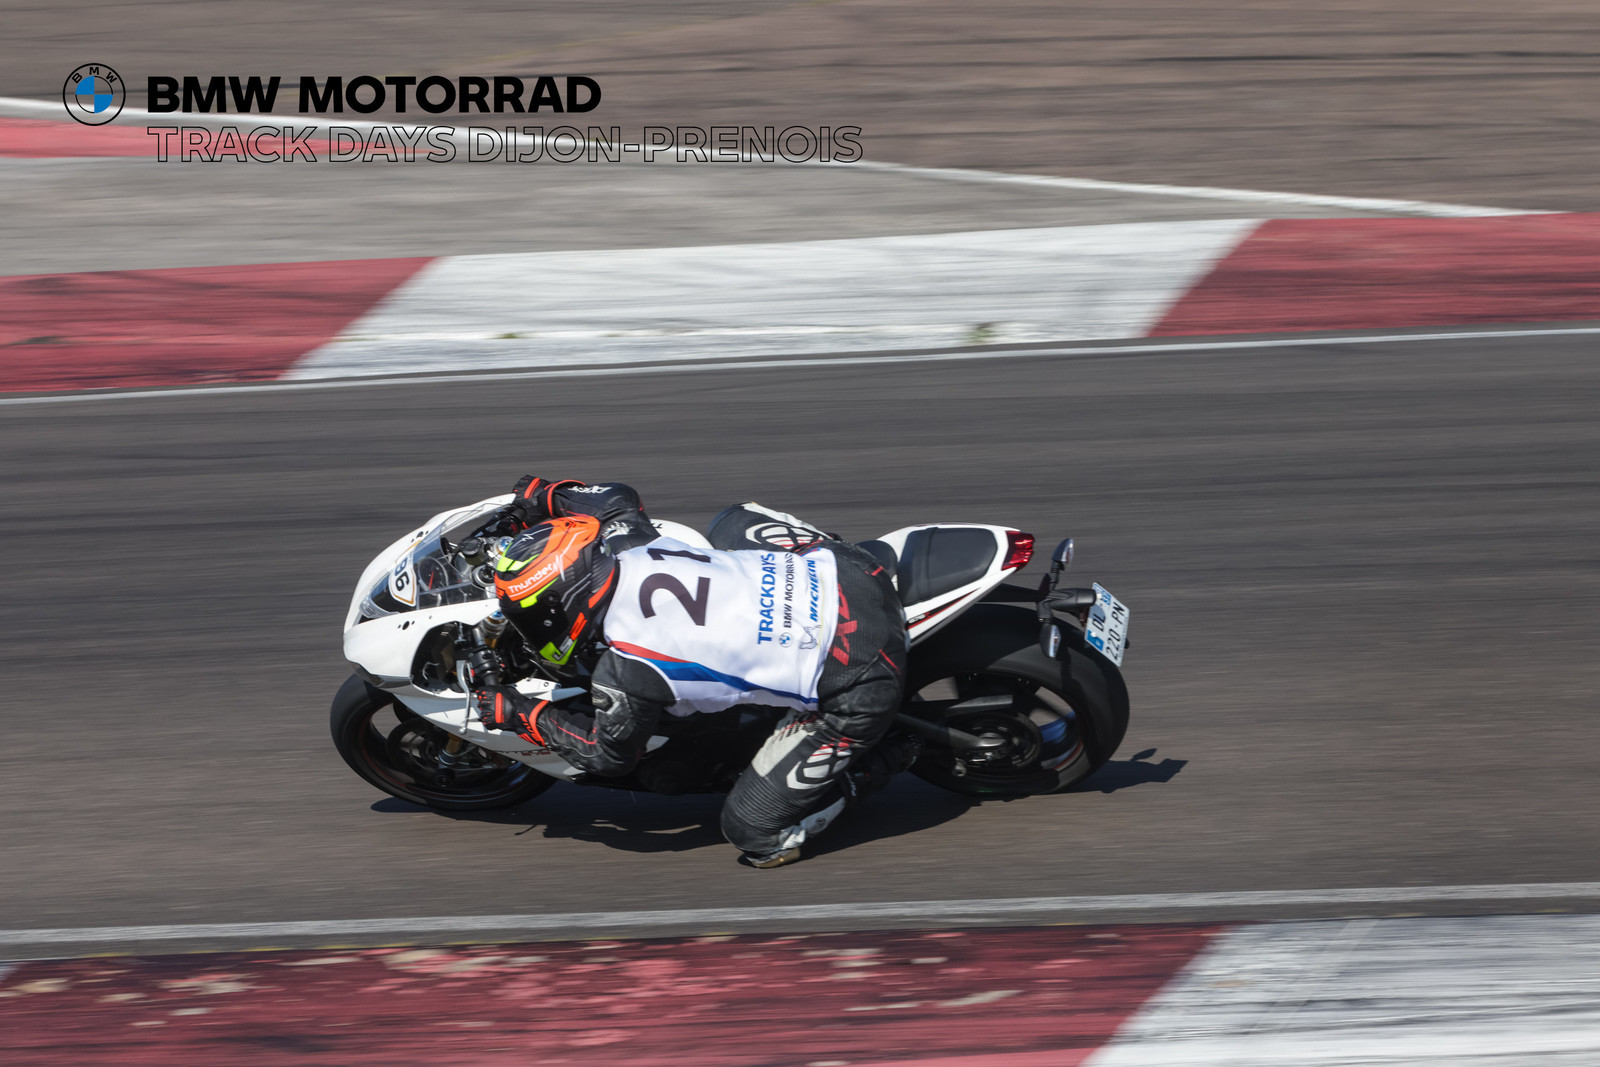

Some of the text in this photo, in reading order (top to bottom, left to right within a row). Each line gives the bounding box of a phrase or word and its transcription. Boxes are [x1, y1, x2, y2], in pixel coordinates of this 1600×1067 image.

[638, 547, 712, 627] 21
[757, 552, 777, 645] TRACKDAYS
[783, 603, 793, 629] BMW
[806, 559, 819, 623] MICHELIN
